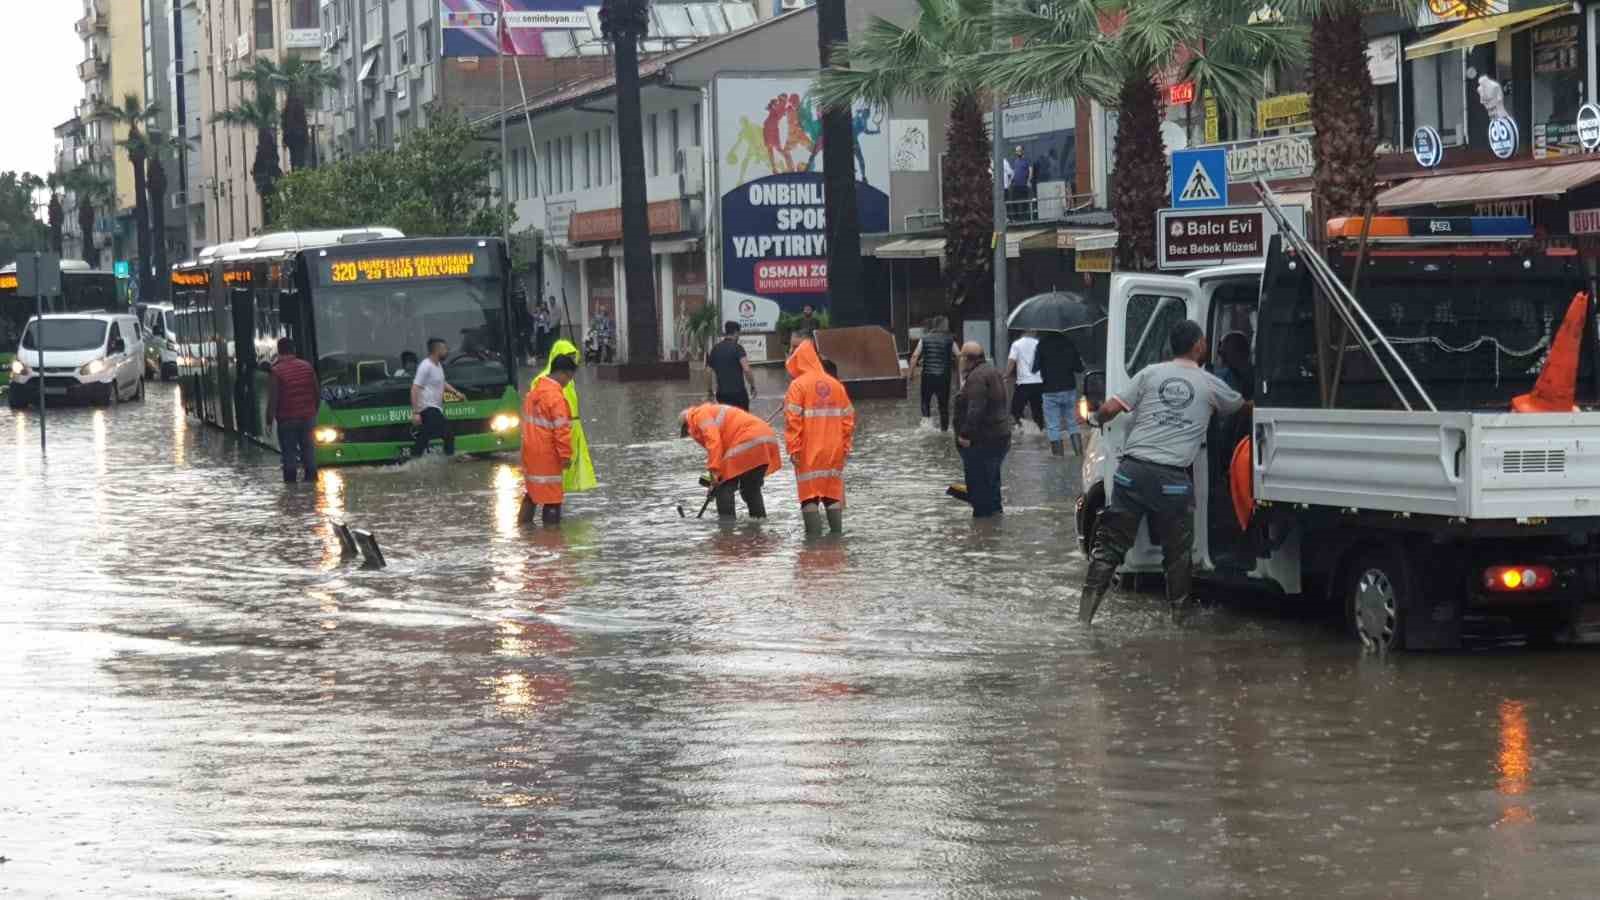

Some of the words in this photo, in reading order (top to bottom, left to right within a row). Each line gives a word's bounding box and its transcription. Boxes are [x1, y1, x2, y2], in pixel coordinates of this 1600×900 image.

[1187, 221, 1224, 236] Balcı
[1229, 219, 1252, 234] Evi
[1168, 245, 1188, 255] Bez
[1190, 243, 1221, 254] Bebek
[1223, 240, 1257, 253] Müzesi
[331, 263, 357, 281] 320
[759, 265, 807, 278] OSMAN
[811, 264, 827, 276] ZO
